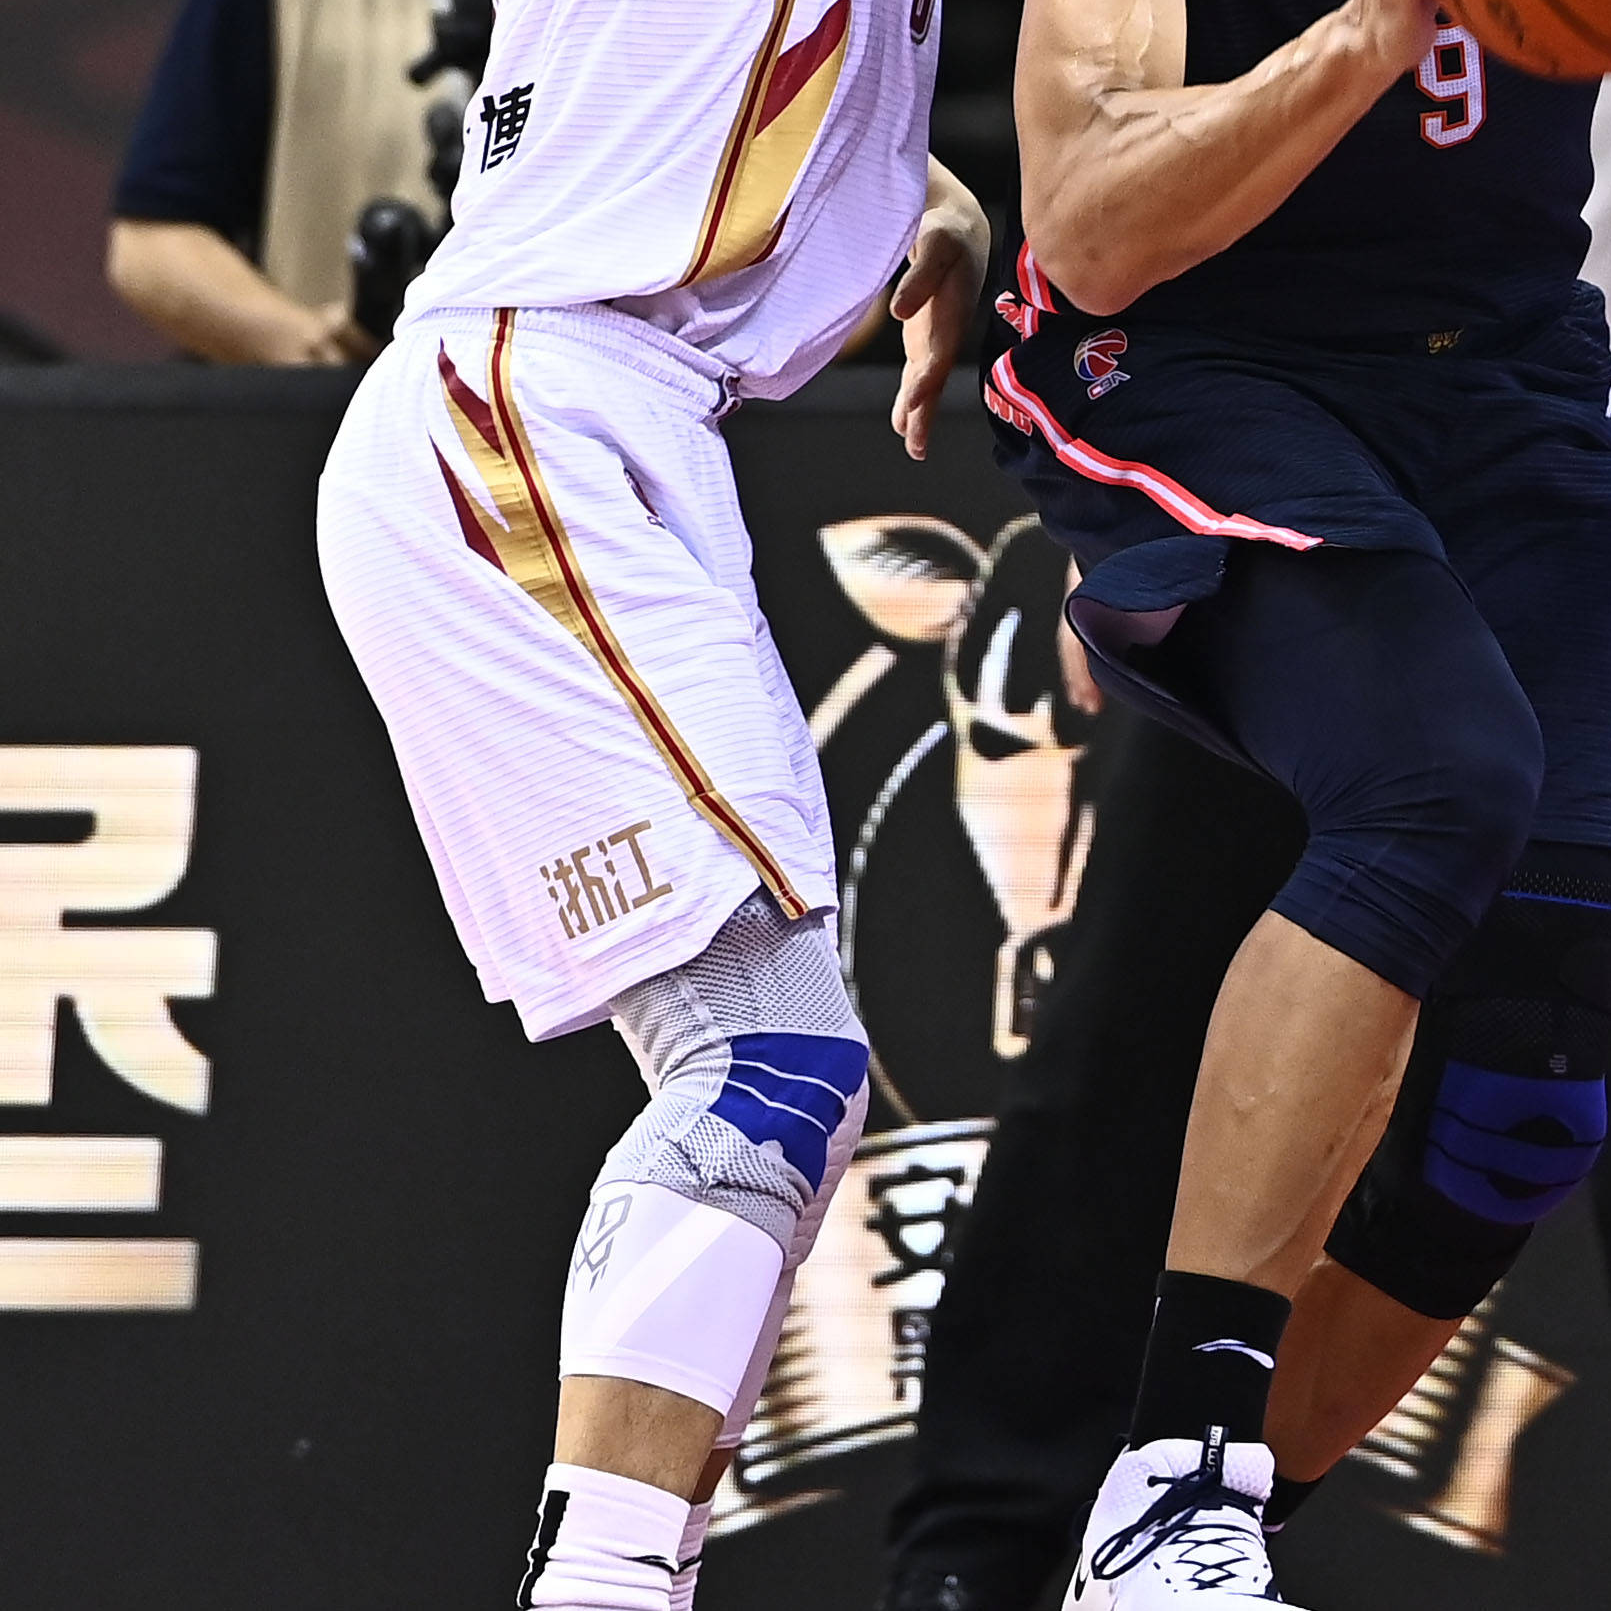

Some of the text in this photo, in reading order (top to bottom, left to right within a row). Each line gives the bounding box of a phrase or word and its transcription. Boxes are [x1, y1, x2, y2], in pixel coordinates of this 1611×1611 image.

[480, 81, 535, 174] 博
[1416, 22, 1487, 149] 9
[539, 819, 674, 940] 浙江
